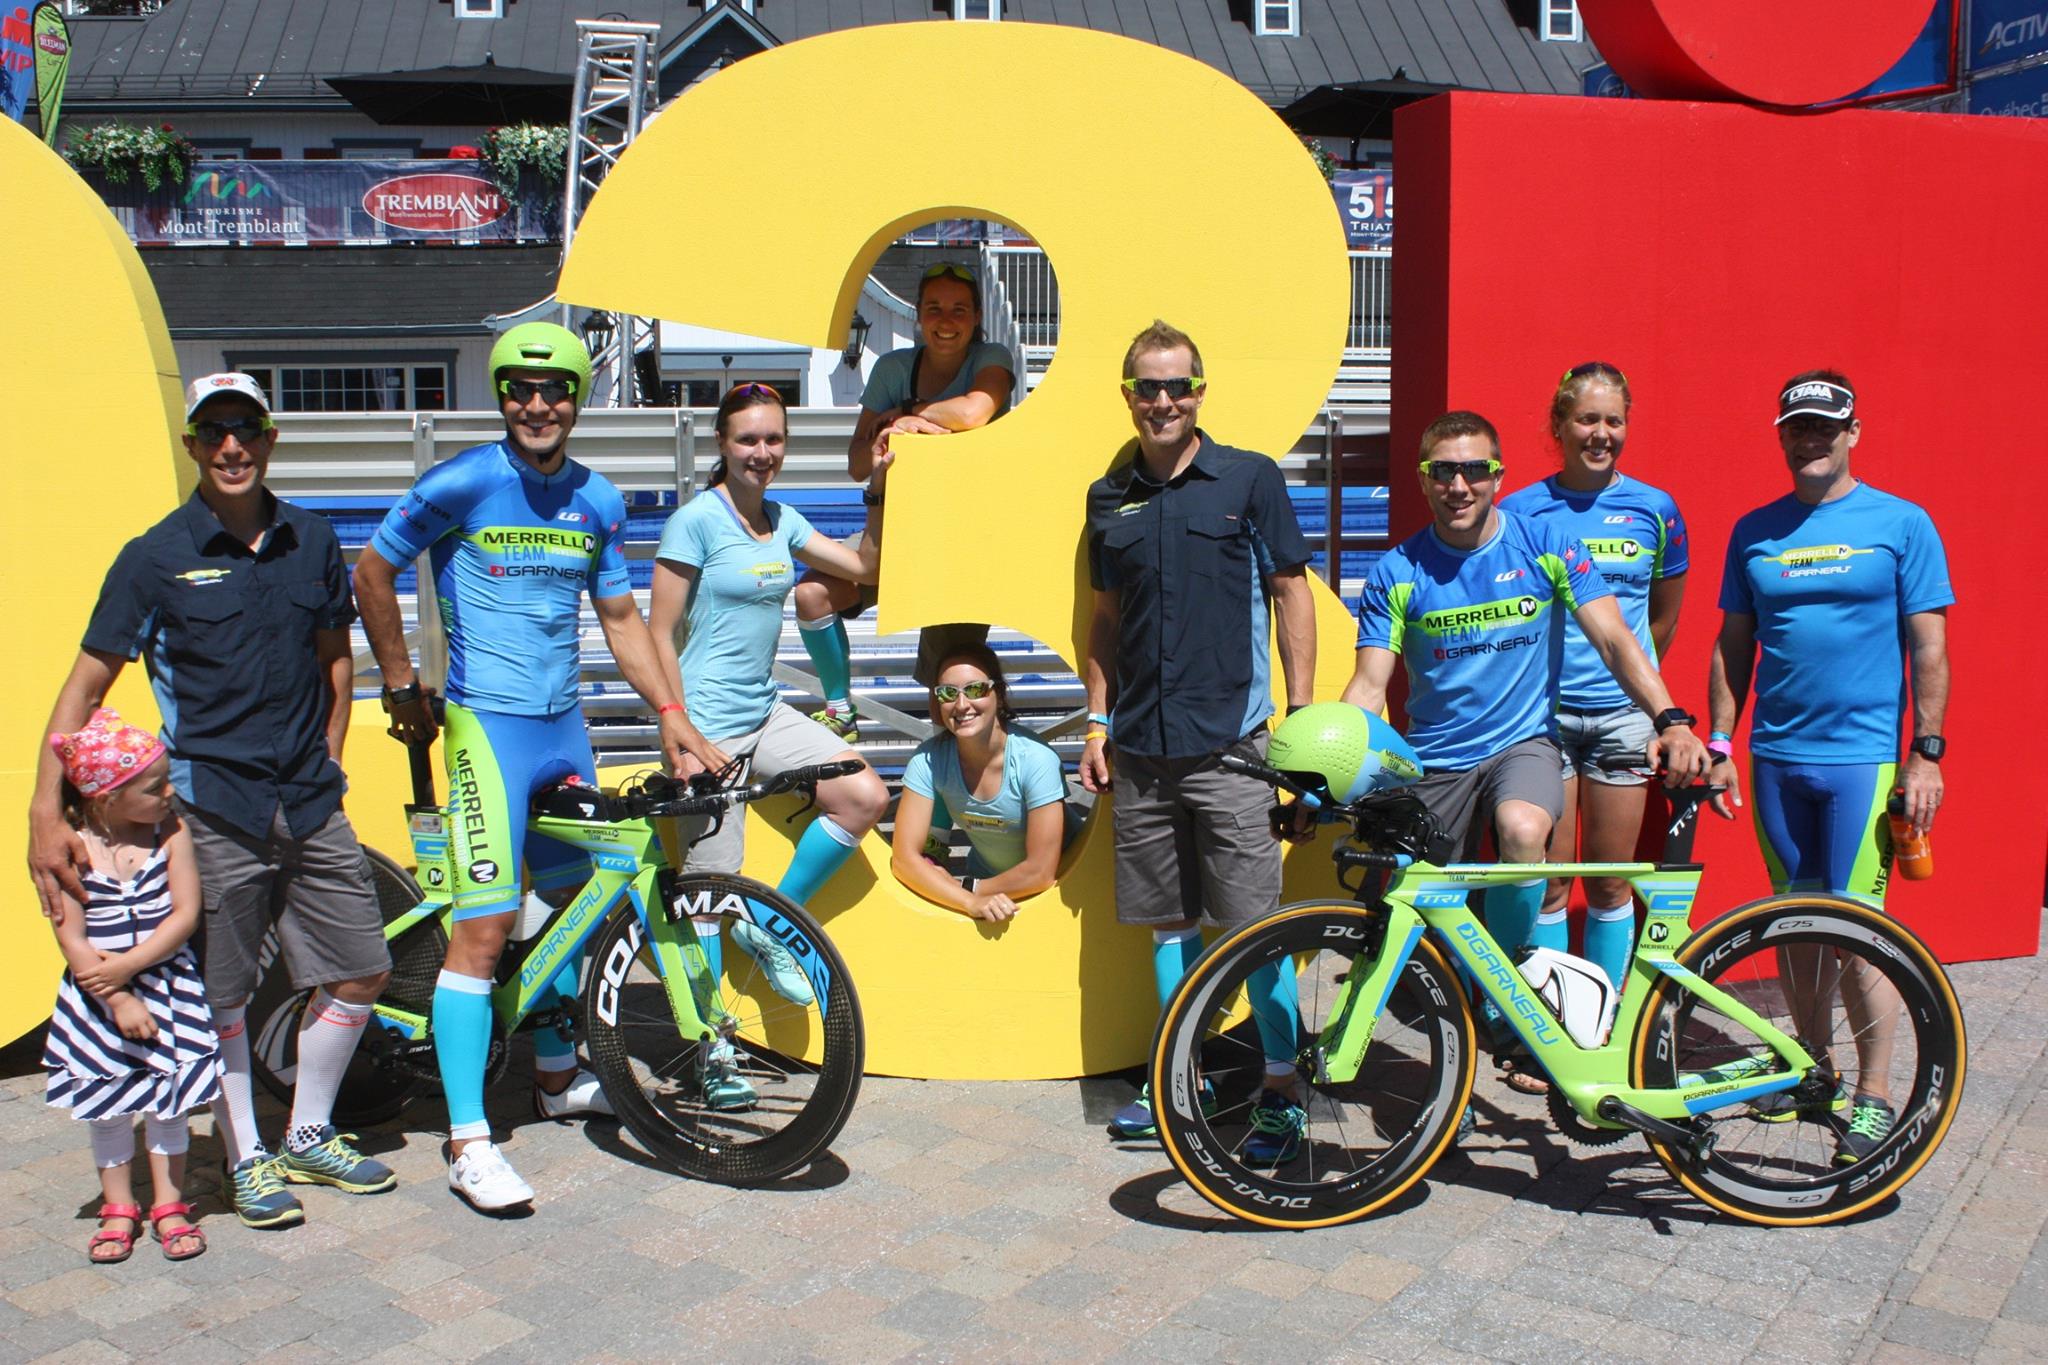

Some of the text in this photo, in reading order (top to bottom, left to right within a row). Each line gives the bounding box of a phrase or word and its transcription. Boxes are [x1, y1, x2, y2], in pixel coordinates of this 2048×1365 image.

[198, 208, 263, 216] TOURISME
[377, 192, 499, 222] TREMBLANT
[159, 218, 300, 234] Mont-Tremblant
[484, 532, 582, 549] MERRELL
[502, 545, 546, 562] TEAM
[1789, 566, 1851, 578] GARNEAU
[1790, 558, 1813, 568] TEAM
[506, 565, 588, 581] GARNEA
[1426, 604, 1518, 629] MERRELL
[1441, 624, 1482, 644] TEAM
[1446, 633, 1538, 659] GARNEAU
[456, 748, 489, 860] MERRELL
[530, 880, 605, 977] GARNEAU
[1468, 937, 1559, 1046] GARNEAU
[1690, 1083, 1740, 1100] GARNEAU
[1184, 1131, 1312, 1209] DURA-ACE
